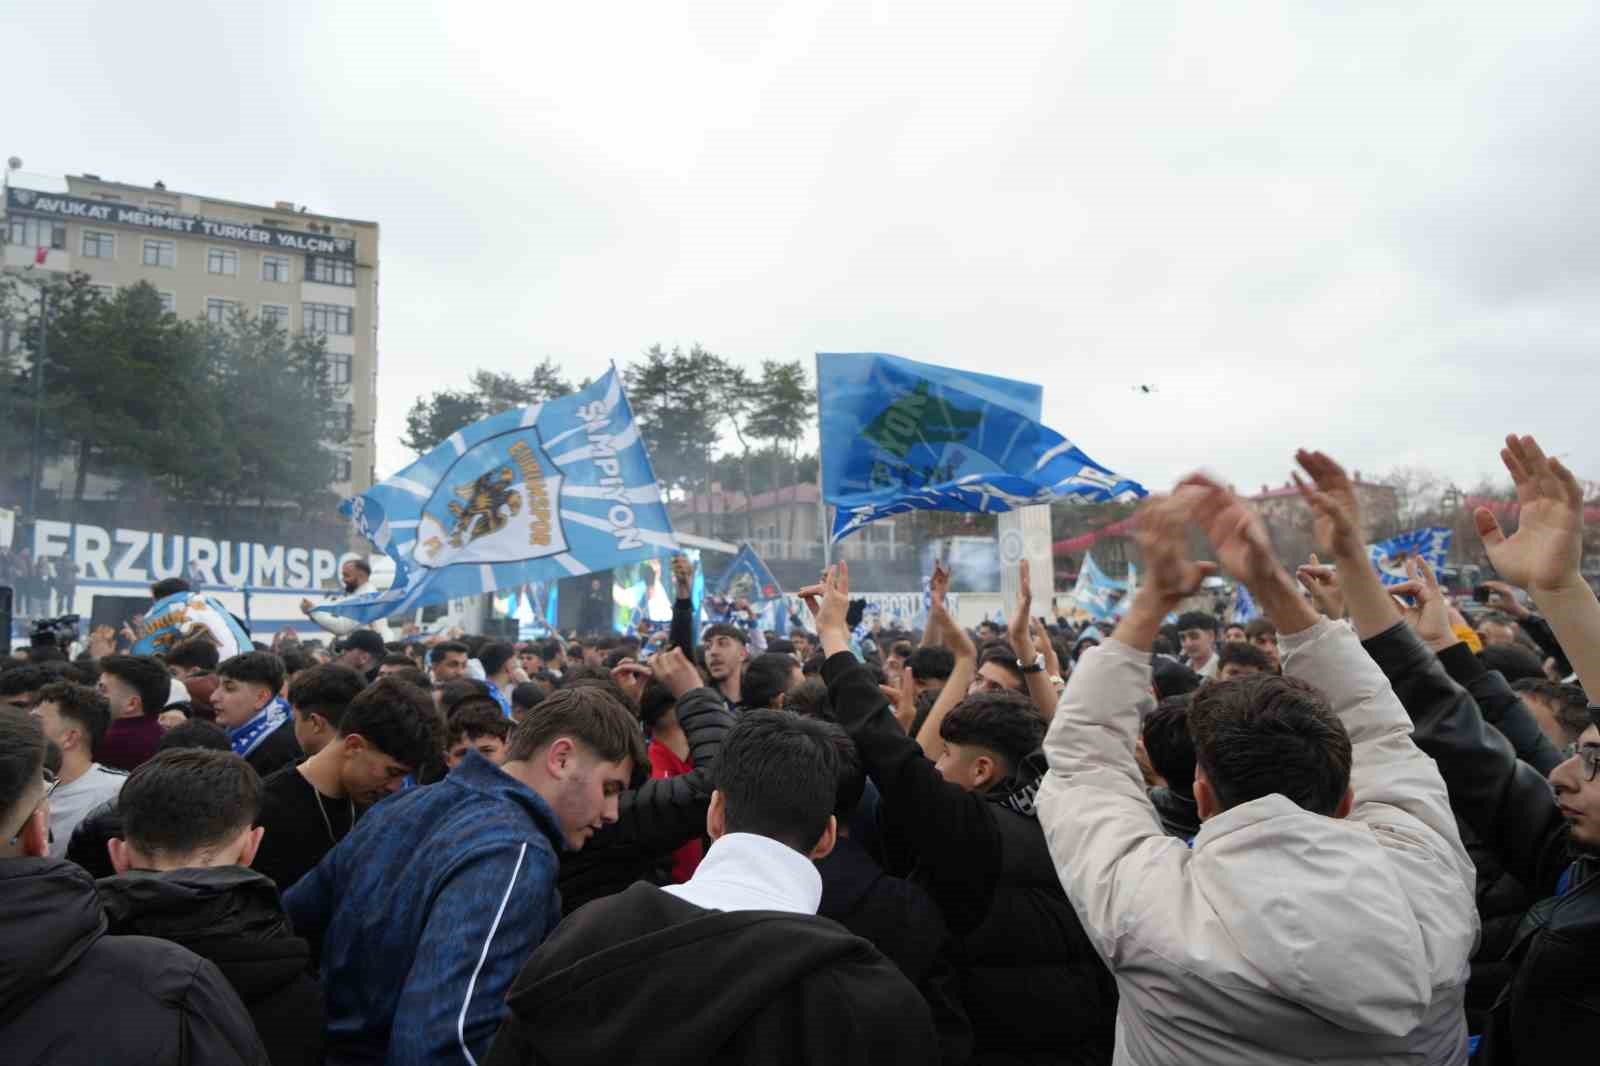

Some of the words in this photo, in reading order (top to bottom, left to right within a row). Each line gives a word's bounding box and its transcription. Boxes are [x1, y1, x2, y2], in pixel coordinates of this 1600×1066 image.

[34, 197, 112, 220] AVUKAT
[117, 209, 196, 232] MEHMET
[33, 518, 364, 593] ERZURUMSPO
